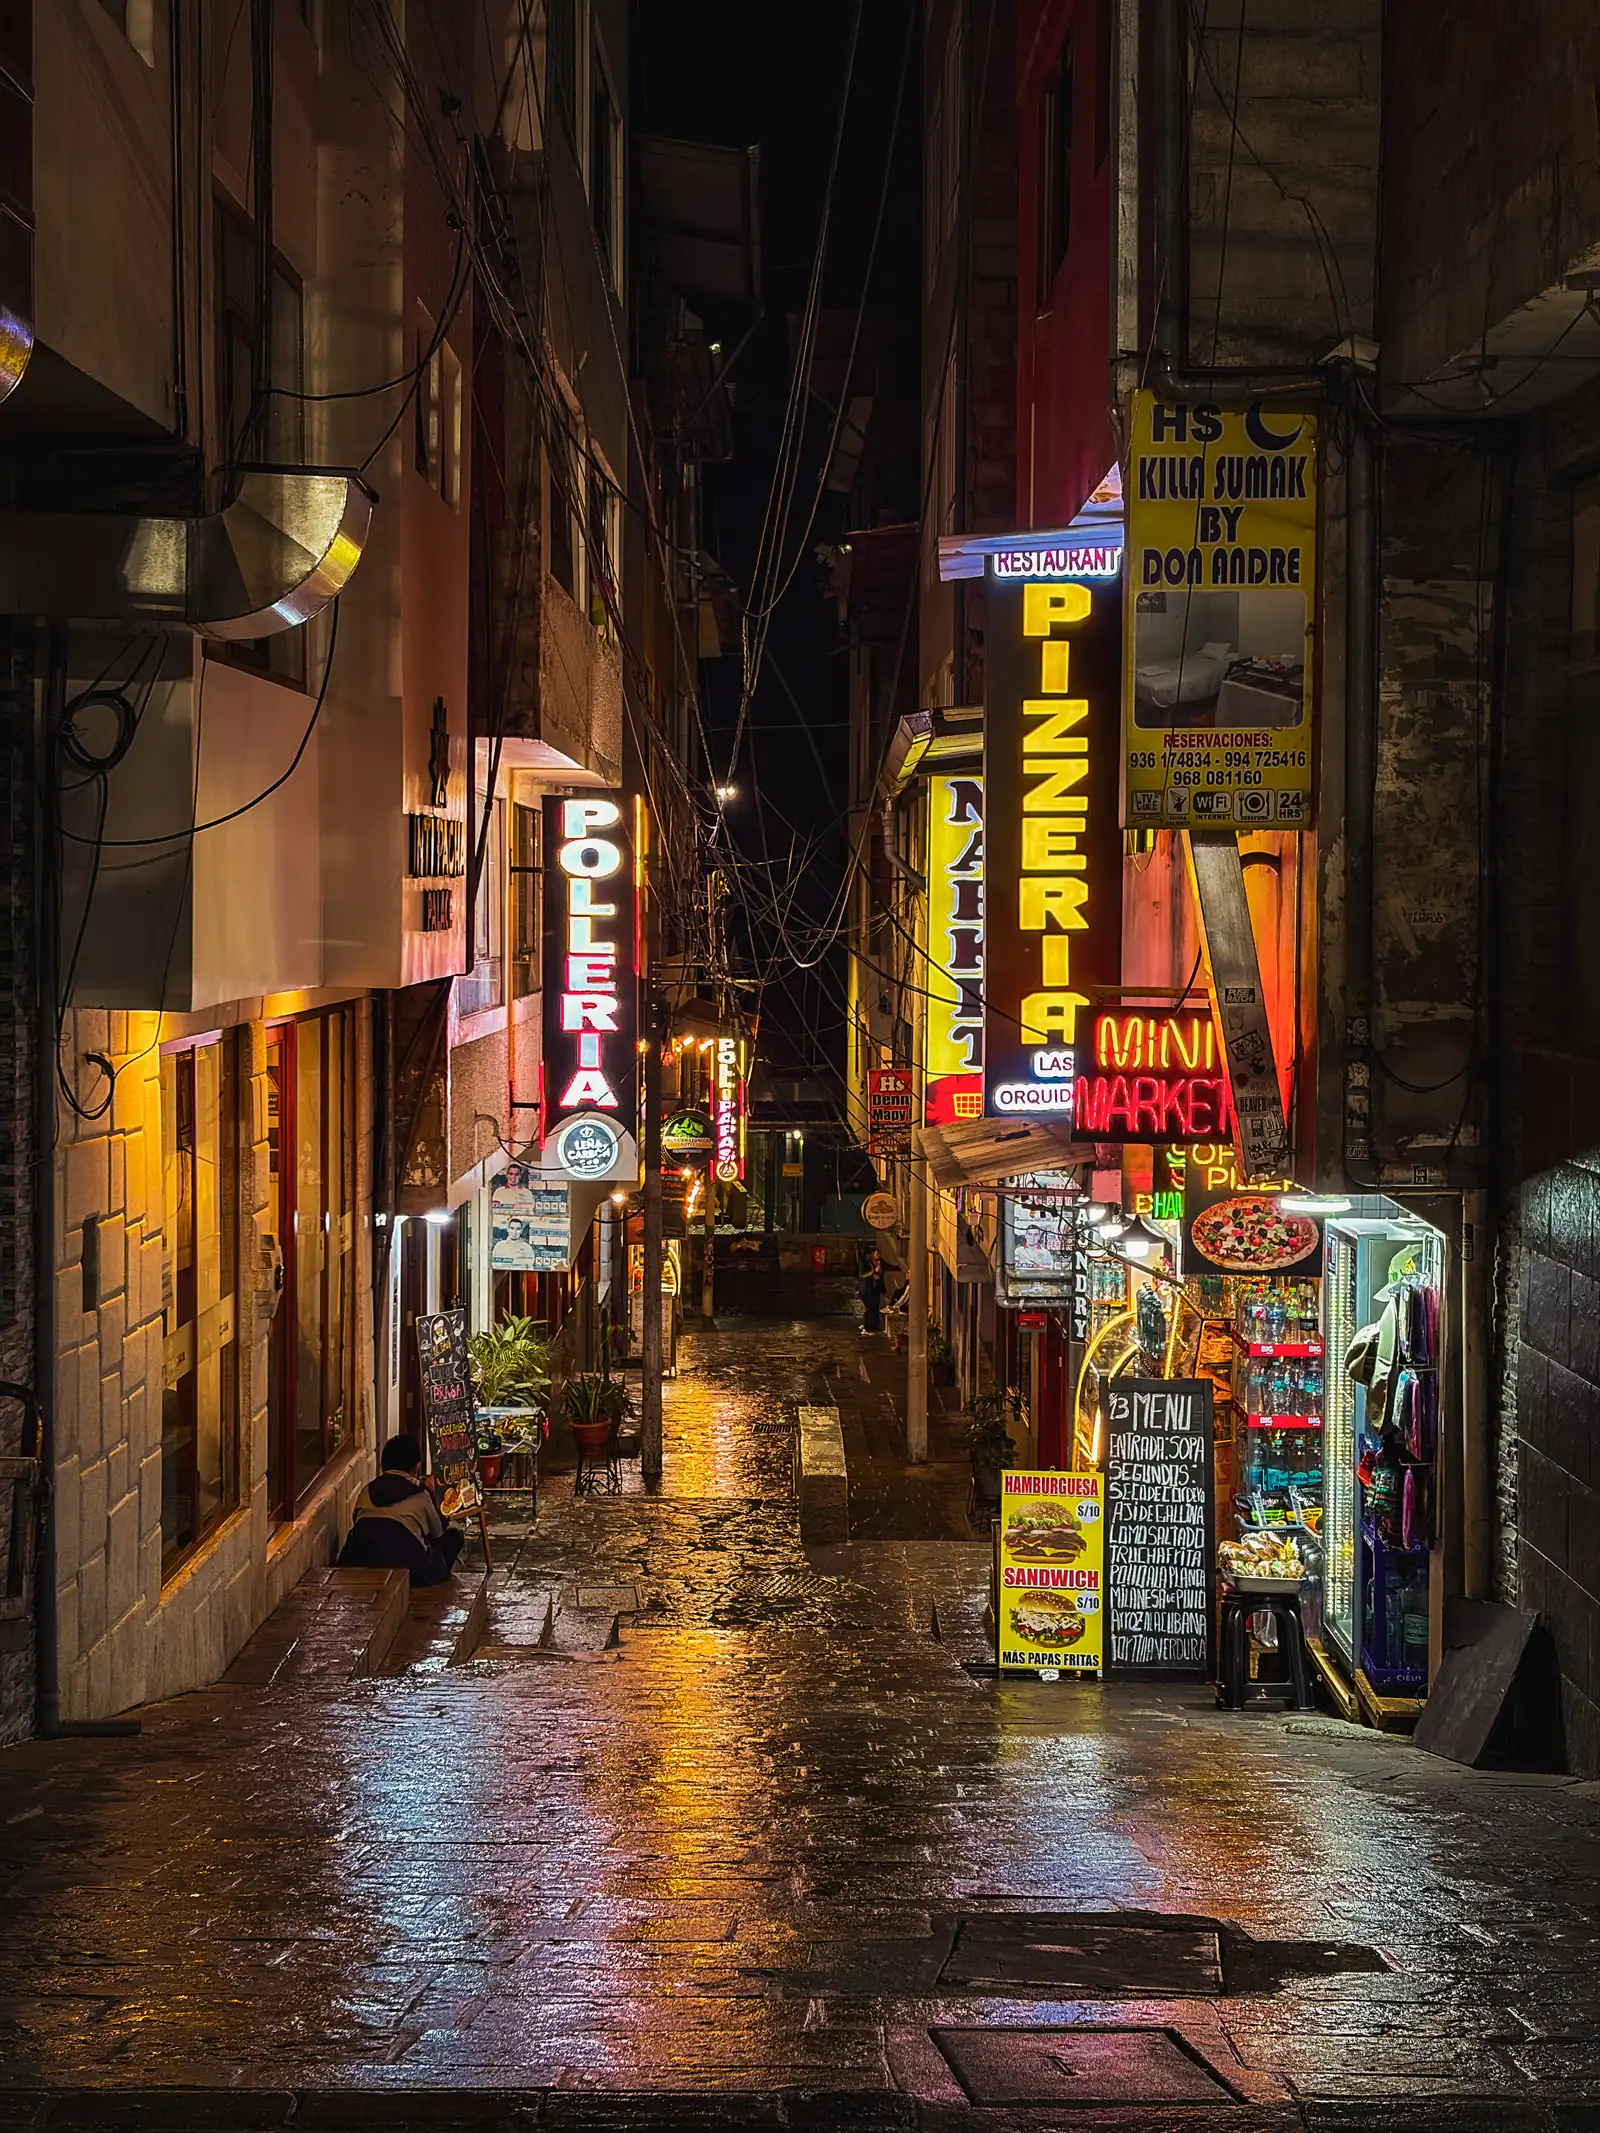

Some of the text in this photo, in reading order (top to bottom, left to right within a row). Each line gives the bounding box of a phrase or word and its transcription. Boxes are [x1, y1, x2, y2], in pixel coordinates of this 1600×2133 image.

[1153, 403, 1223, 442] HS
[1139, 455, 1307, 500] KILLA SUMAK
[1200, 506, 1244, 543] BY
[998, 546, 1118, 573] RESTAURANT
[1143, 548, 1300, 585] DON ANDRE
[1164, 733, 1273, 748] RESERVACIONES:
[1130, 753, 1155, 768] 936
[1161, 751, 1211, 767] 174834
[1225, 752, 1250, 767] 994
[1255, 750, 1306, 767] 725416
[1173, 770, 1262, 785] 968 081160
[1280, 793, 1302, 809] 24
[1019, 583, 1092, 1045] PIZZERIA
[1279, 808, 1301, 819] HRS
[559, 800, 621, 1108] POLLERIA
[1100, 1016, 1213, 1070] MINI
[1040, 1057, 1073, 1071] LAS
[1076, 1075, 1227, 1134] MARKET
[1133, 1392, 1192, 1431] MENU
[1169, 1435, 1205, 1463] SOPA
[1004, 1475, 1099, 1497] HAMBURGUESA
[1077, 1506, 1100, 1518] S/10
[1109, 1524, 1205, 1549] LOMO SALTADO
[1109, 1545, 1165, 1564] TRUCHA
[1003, 1567, 1100, 1590] SANDWICH
[1077, 1598, 1100, 1610] S/10
[1002, 1650, 1100, 1667] MÁS PAPAS FRITAS
